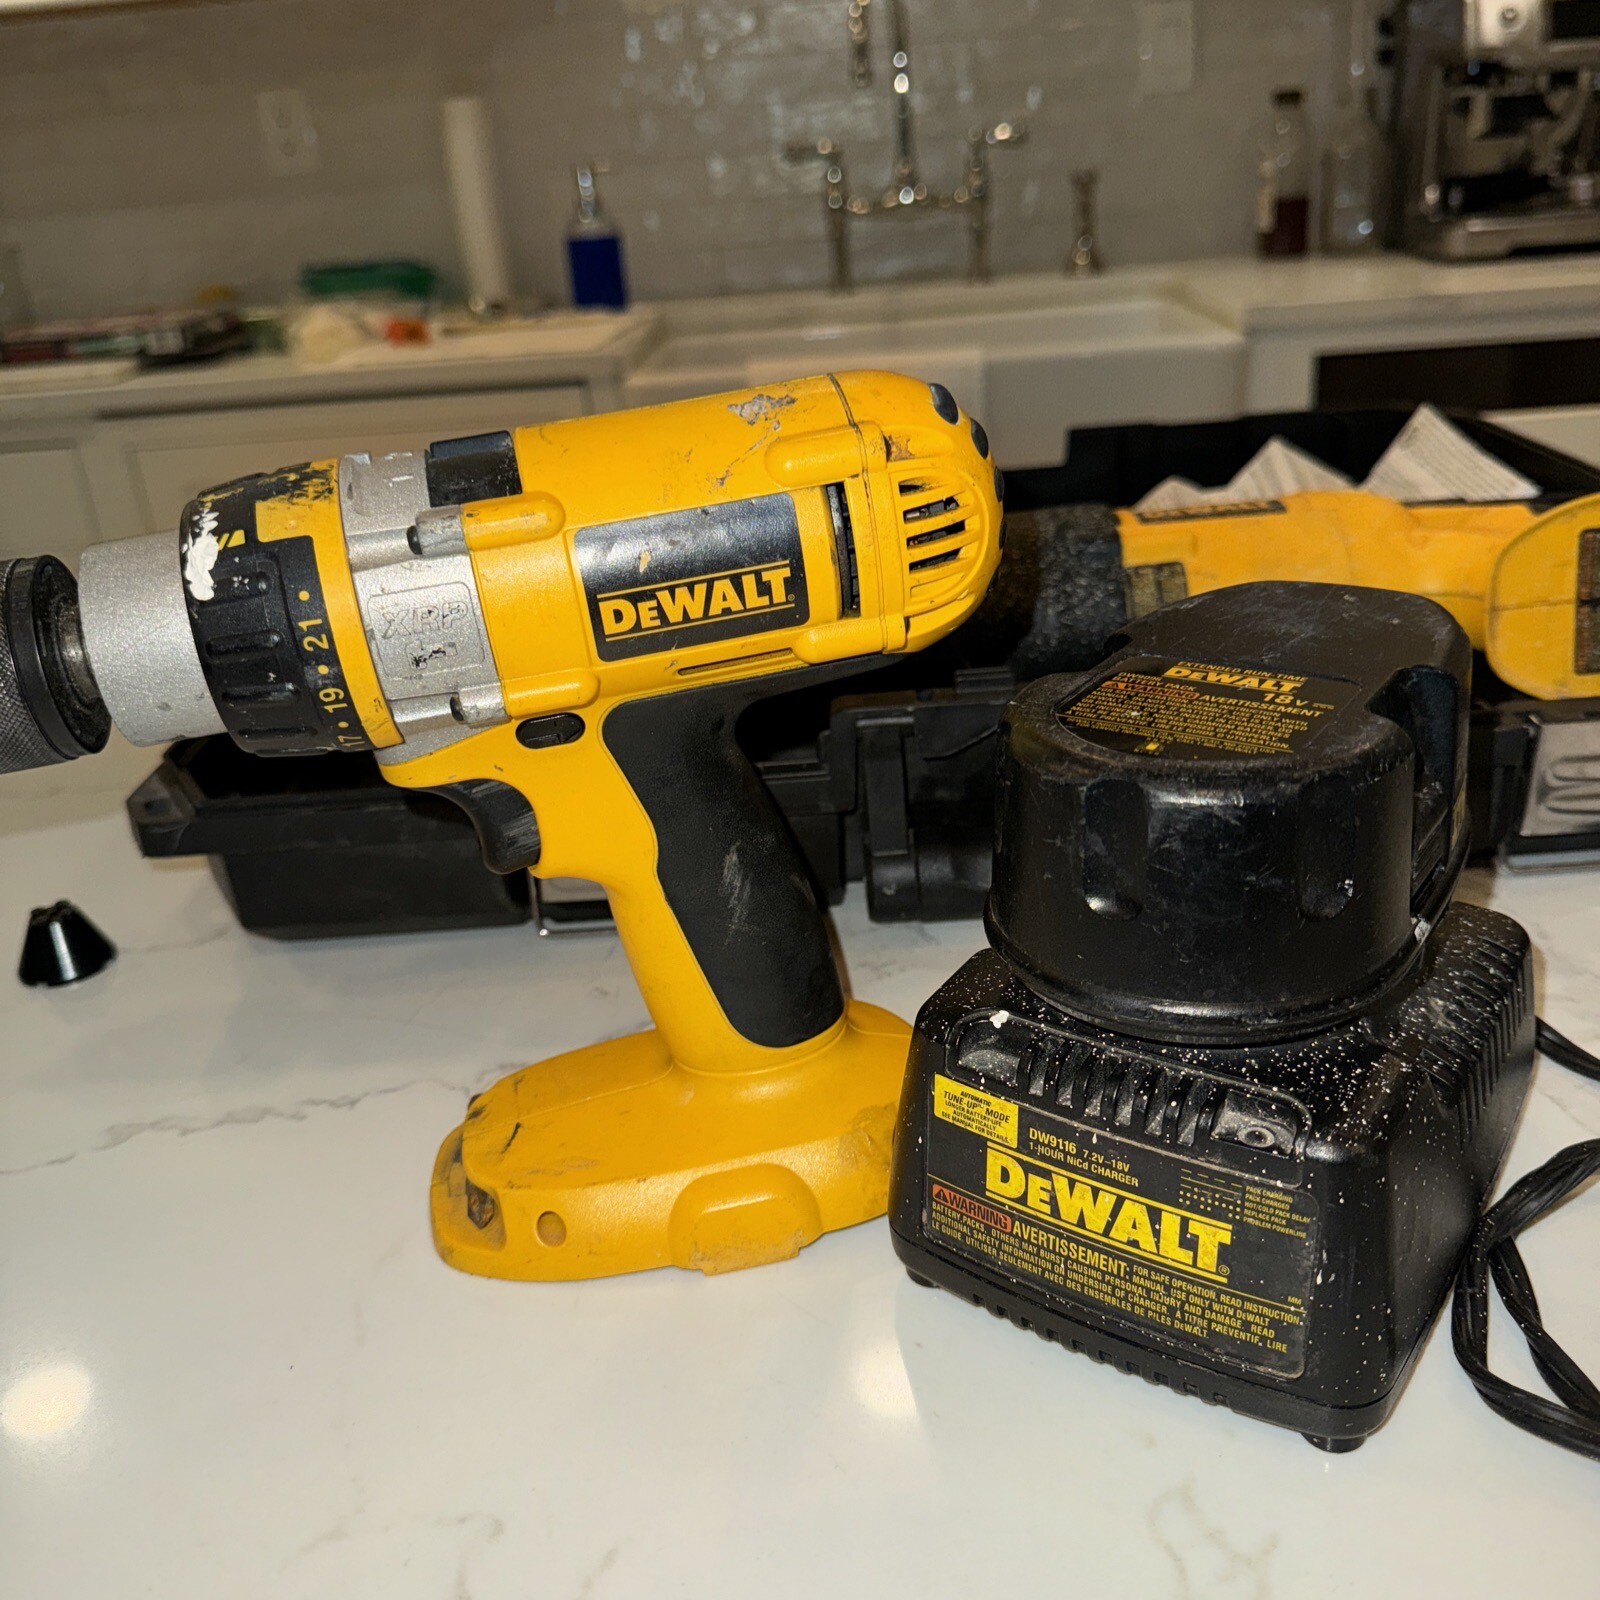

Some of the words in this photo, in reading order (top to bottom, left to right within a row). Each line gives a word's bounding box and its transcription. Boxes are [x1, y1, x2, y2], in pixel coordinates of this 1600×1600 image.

[599, 567, 793, 635] DEWALT
[382, 600, 469, 639] XRP
[298, 618, 330, 651] 21
[1163, 667, 1304, 692] DEWALT
[1177, 661, 1242, 673] EXTENDED
[1244, 669, 1308, 682] RUN-TIME
[319, 687, 348, 713] 19
[1123, 684, 1196, 699] WARNING
[1198, 695, 1324, 718] AVERTISSEMENT
[945, 1099, 964, 1113] LONGER
[960, 1090, 991, 1106] AUTOMATIC
[952, 1115, 973, 1129] MANUAL
[975, 1125, 984, 1133] FOR
[985, 1107, 1009, 1123] MODE
[1029, 1127, 1076, 1154] DW9116
[1029, 1141, 1063, 1161] 1-HOUR
[1066, 1154, 1088, 1170] NiCd
[1091, 1163, 1138, 1187] CHARGER
[1245, 1185, 1261, 1194] PACK
[1262, 1190, 1293, 1203] CHARGING
[1245, 1192, 1260, 1202] PACK
[1261, 1197, 1289, 1210] CHARGED
[948, 1191, 1007, 1230] WARNING
[986, 1147, 1232, 1273] DEWALT
[1243, 1208, 1269, 1221] REPLACE
[1243, 1216, 1271, 1229] PROBLEM
[1291, 1213, 1310, 1223] DELAY
[931, 1219, 938, 1230] LE
[965, 1235, 996, 1256] UTILISER
[999, 1250, 1041, 1276] SEULEMENT
[1044, 1270, 1063, 1285] AVEC
[1066, 1278, 1081, 1292] DES
[1083, 1285, 1131, 1311] ENSEMBLES
[1134, 1304, 1144, 1316] DE
[1147, 1309, 1170, 1325] PILES
[931, 1211, 970, 1236] ADDITIONAL
[972, 1229, 999, 1248] SAFETY
[1001, 1242, 1051, 1270] INFORMATION
[1053, 1264, 1064, 1275] ON
[1067, 1270, 1112, 1294] UNDERSIDE
[1114, 1287, 1125, 1299] OF
[1184, 1312, 1207, 1328] TITRE
[1266, 1339, 1287, 1353] LIRE
[991, 1228, 1019, 1247] OTHERS
[1021, 1240, 1037, 1254] MAY
[1039, 1248, 1063, 1265] BURST
[1067, 1259, 1101, 1280] CAUSING
[1104, 1273, 1147, 1297] PERSONAL
[1150, 1290, 1181, 1309] INJURY
[1183, 1302, 1201, 1316] AND
[1250, 1323, 1274, 1339] READ
[1133, 1264, 1148, 1277] FOR
[1150, 1270, 1169, 1285] SAFE
[1220, 1292, 1241, 1308] READ
[1243, 1300, 1299, 1325] INSTRUCTION
[1170, 1287, 1186, 1300] USE
[1188, 1293, 1209, 1308] ONLY
[1212, 1301, 1234, 1316] WITH
[1236, 1309, 1269, 1327] DEWALT
